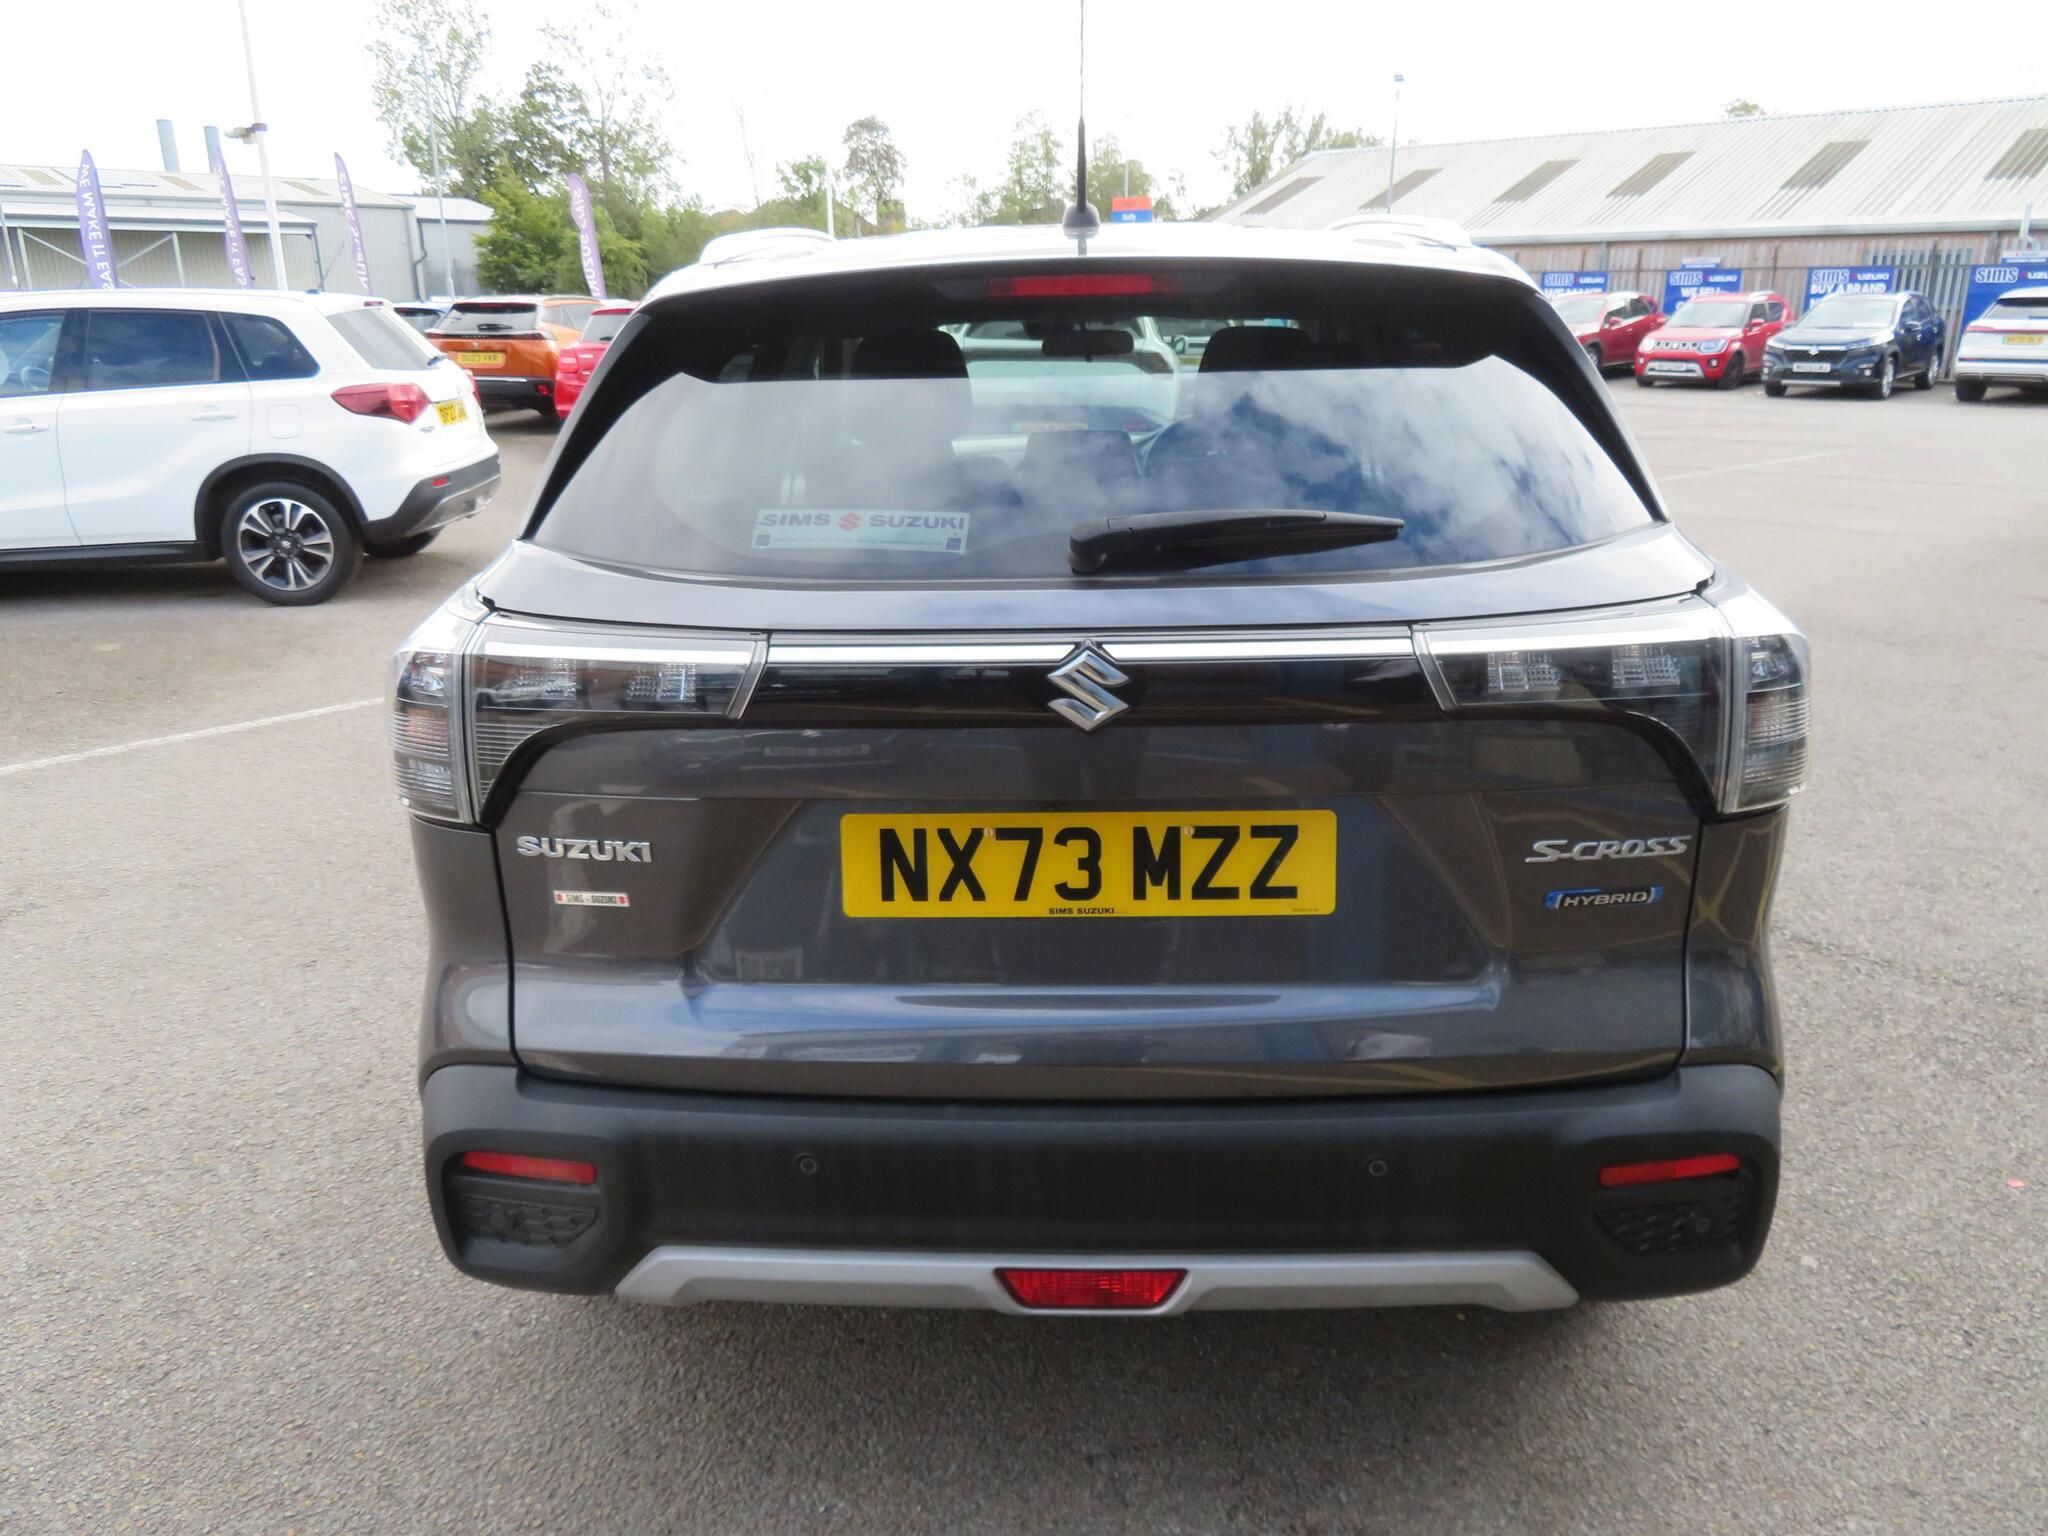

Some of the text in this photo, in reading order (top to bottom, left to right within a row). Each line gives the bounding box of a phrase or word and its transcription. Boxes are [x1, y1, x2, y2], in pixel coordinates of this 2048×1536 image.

[1810, 282, 1834, 294] BUY
[1846, 282, 1887, 294] BRAND
[758, 513, 966, 530] SIMS SUZUKI
[517, 835, 653, 863] SUZUKI
[1525, 835, 1692, 863] S-CROSS
[880, 824, 1300, 902] NX73 MZZ
[591, 895, 617, 904] SUZUKI
[1563, 891, 1648, 907] HYBRID
[1077, 907, 1115, 915] SUZUKI
